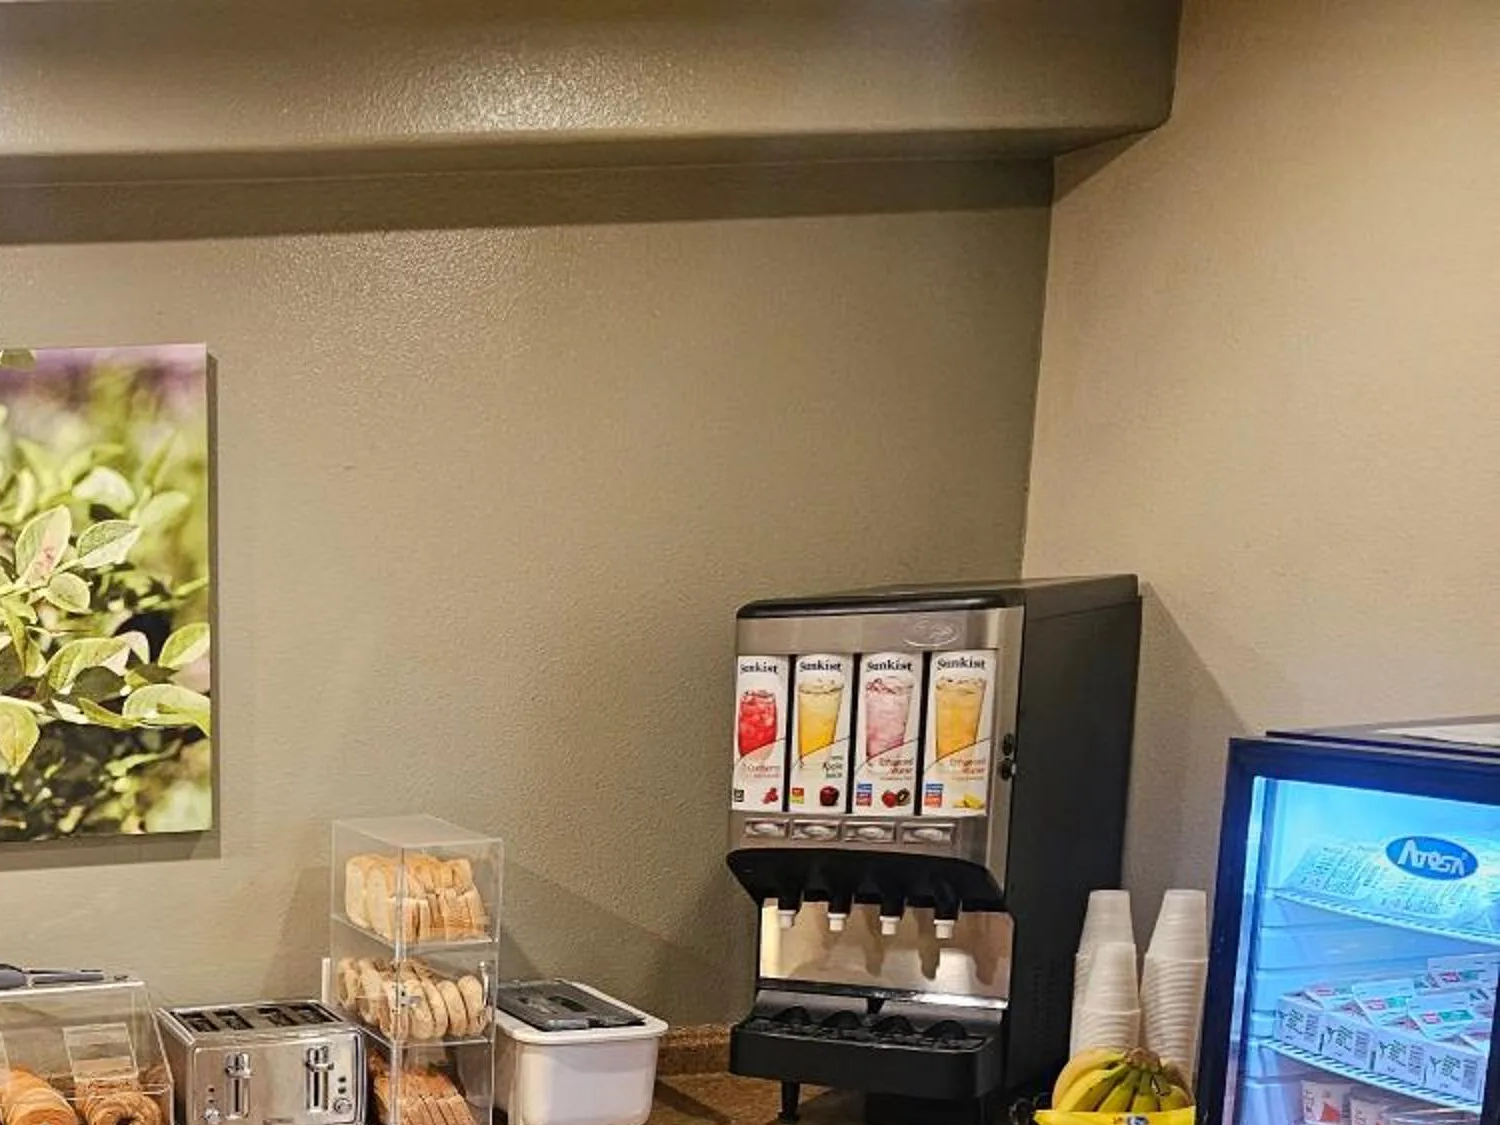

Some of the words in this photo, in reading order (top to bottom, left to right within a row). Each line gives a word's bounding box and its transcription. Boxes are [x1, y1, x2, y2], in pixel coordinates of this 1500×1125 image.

[740, 660, 779, 675] Sunkist
[799, 657, 843, 673] Sunkist
[866, 657, 914, 673] Sunkist
[937, 655, 986, 671] Sunkist
